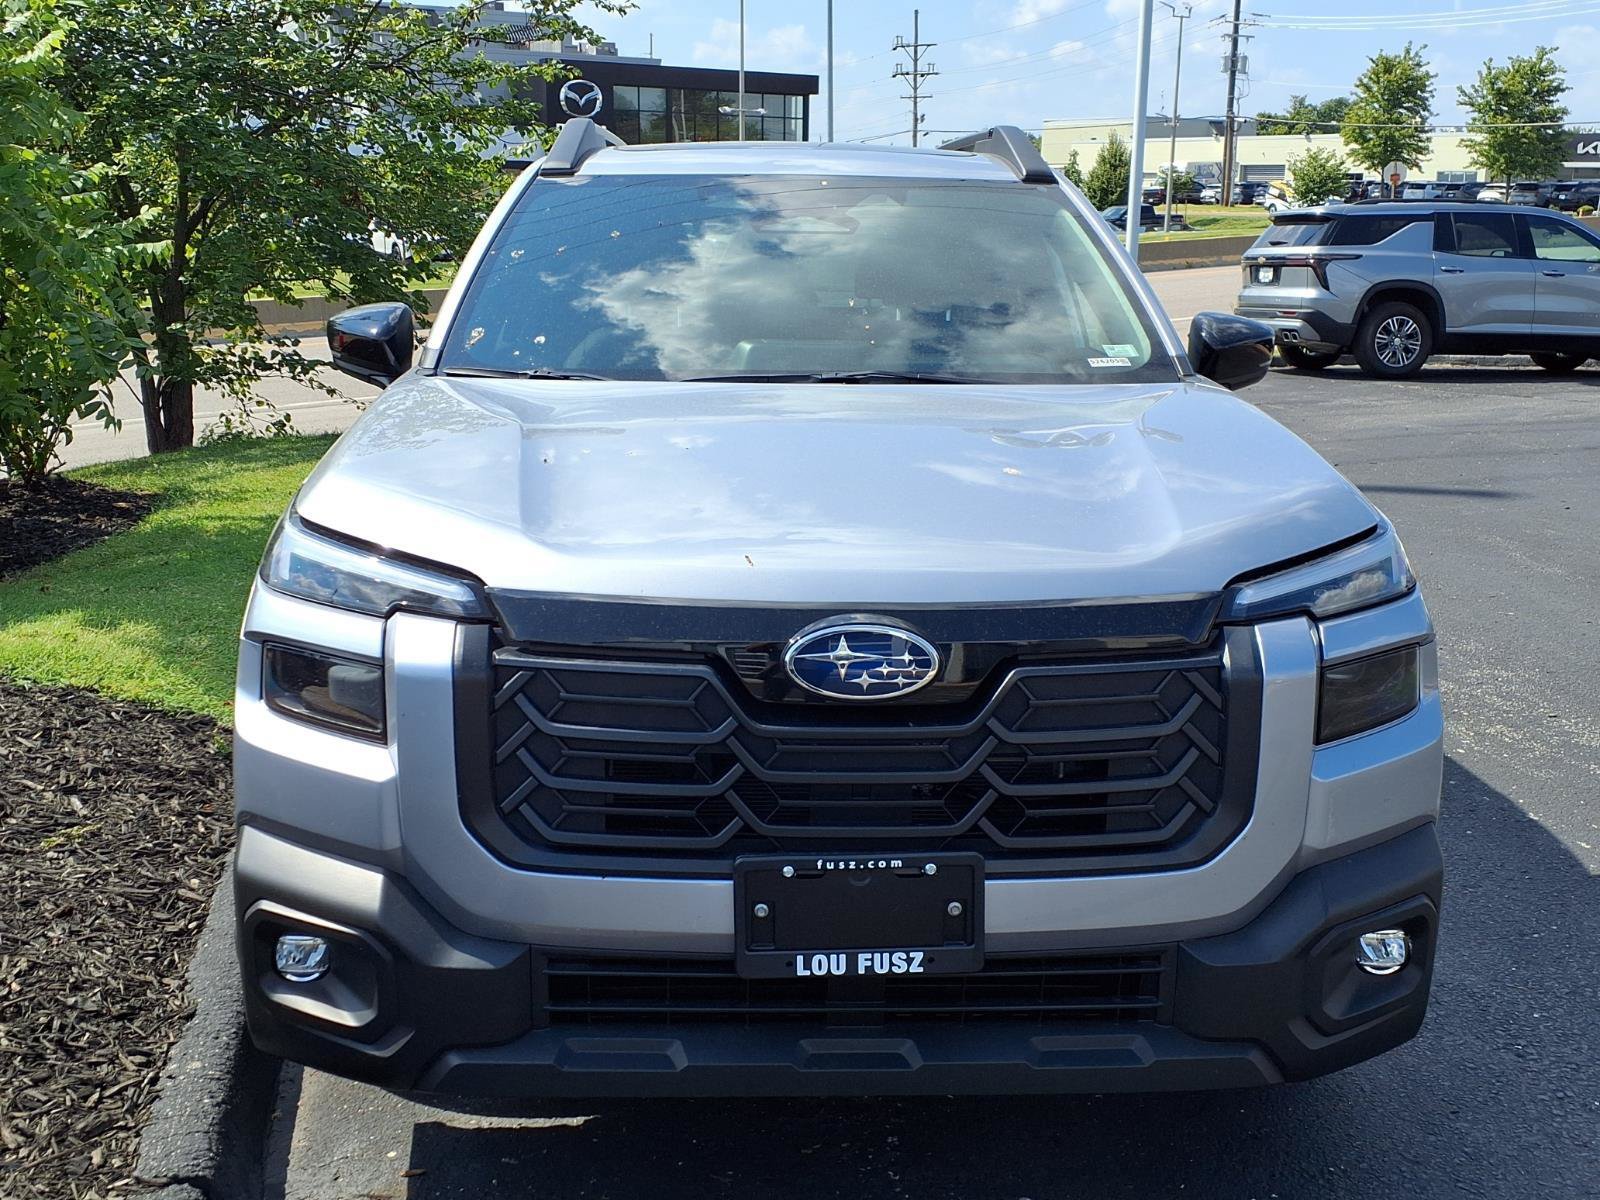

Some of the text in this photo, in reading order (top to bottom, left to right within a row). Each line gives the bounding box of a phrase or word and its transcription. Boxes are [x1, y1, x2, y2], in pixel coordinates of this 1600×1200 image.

[816, 859, 903, 870] fusz.com
[796, 952, 924, 976] LOU FUSZ
